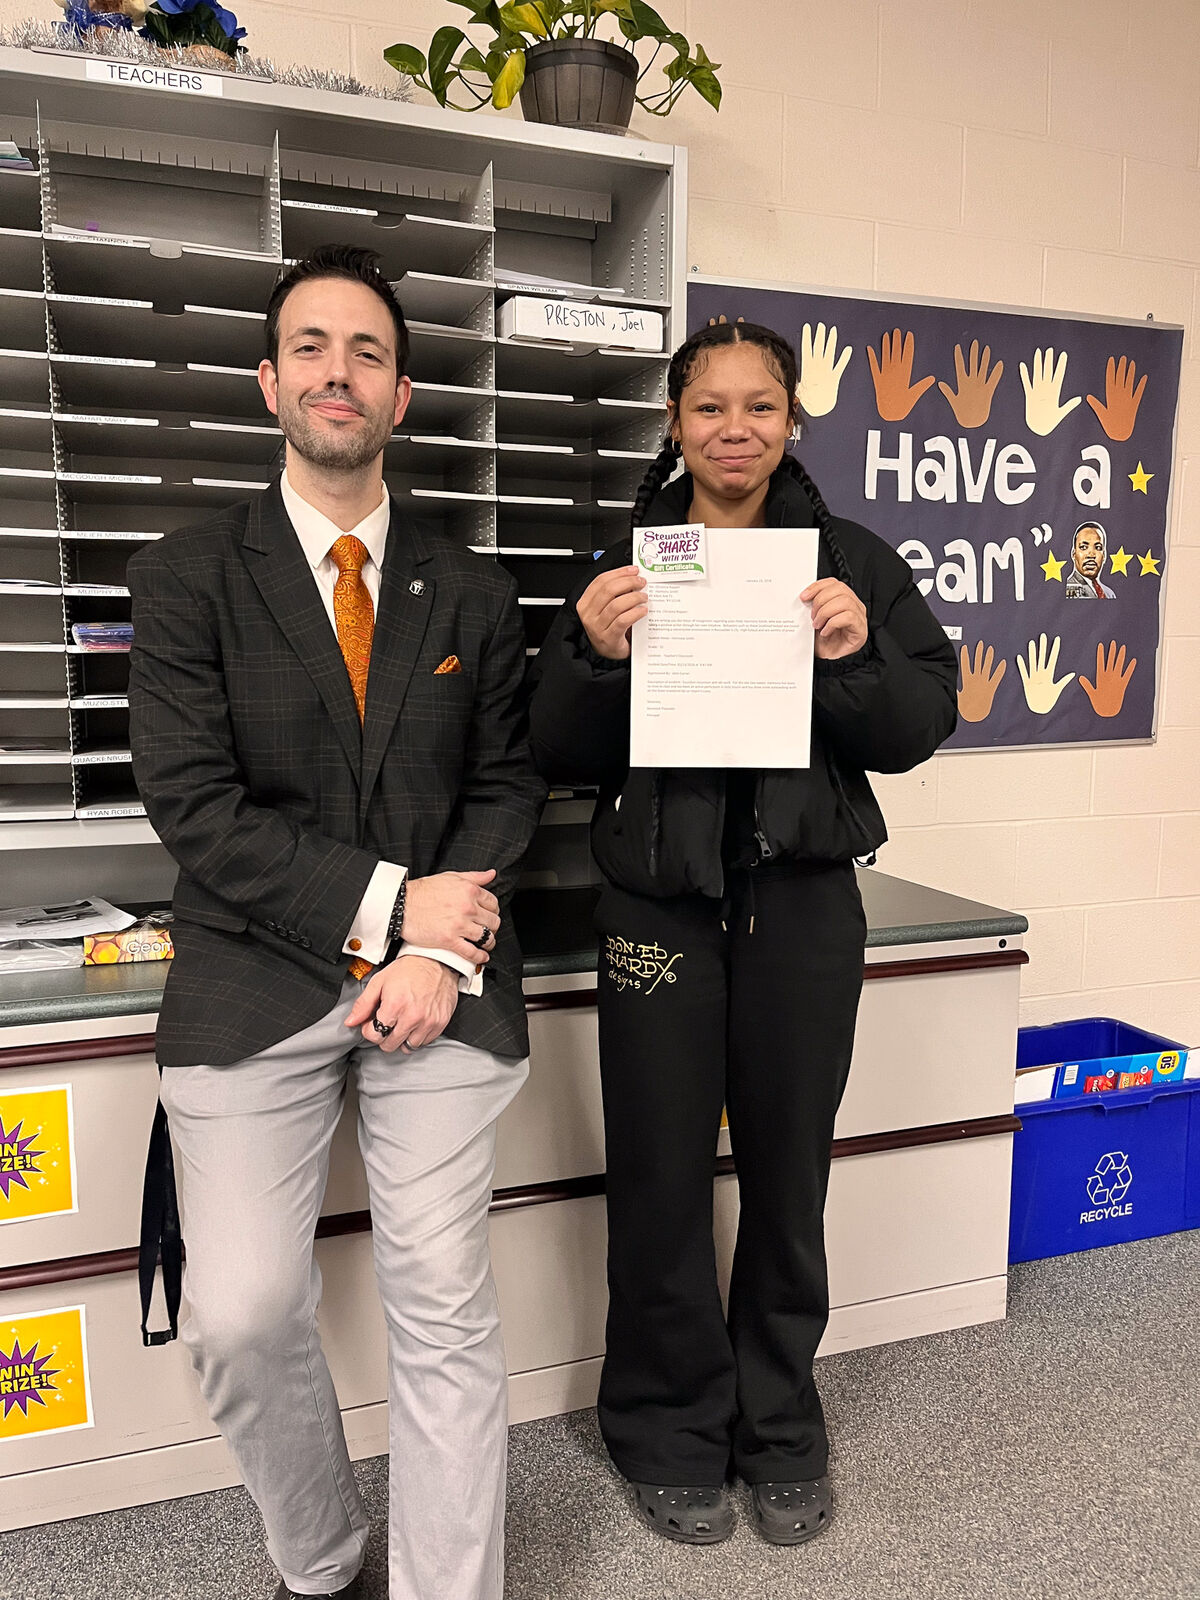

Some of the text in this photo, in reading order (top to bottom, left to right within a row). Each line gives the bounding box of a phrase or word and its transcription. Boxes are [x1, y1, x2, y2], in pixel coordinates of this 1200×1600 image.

[106, 63, 203, 91] TEACHERS
[618, 311, 644, 332] Joel
[864, 429, 1111, 509] Have a
[657, 539, 700, 554] SHARES
[661, 553, 697, 562] WITH YOU!
[665, 563, 695, 571] Certificate
[608, 968, 641, 992] designs
[1160, 1056, 1173, 1070] 50
[1079, 1203, 1133, 1224] RECYCLE
